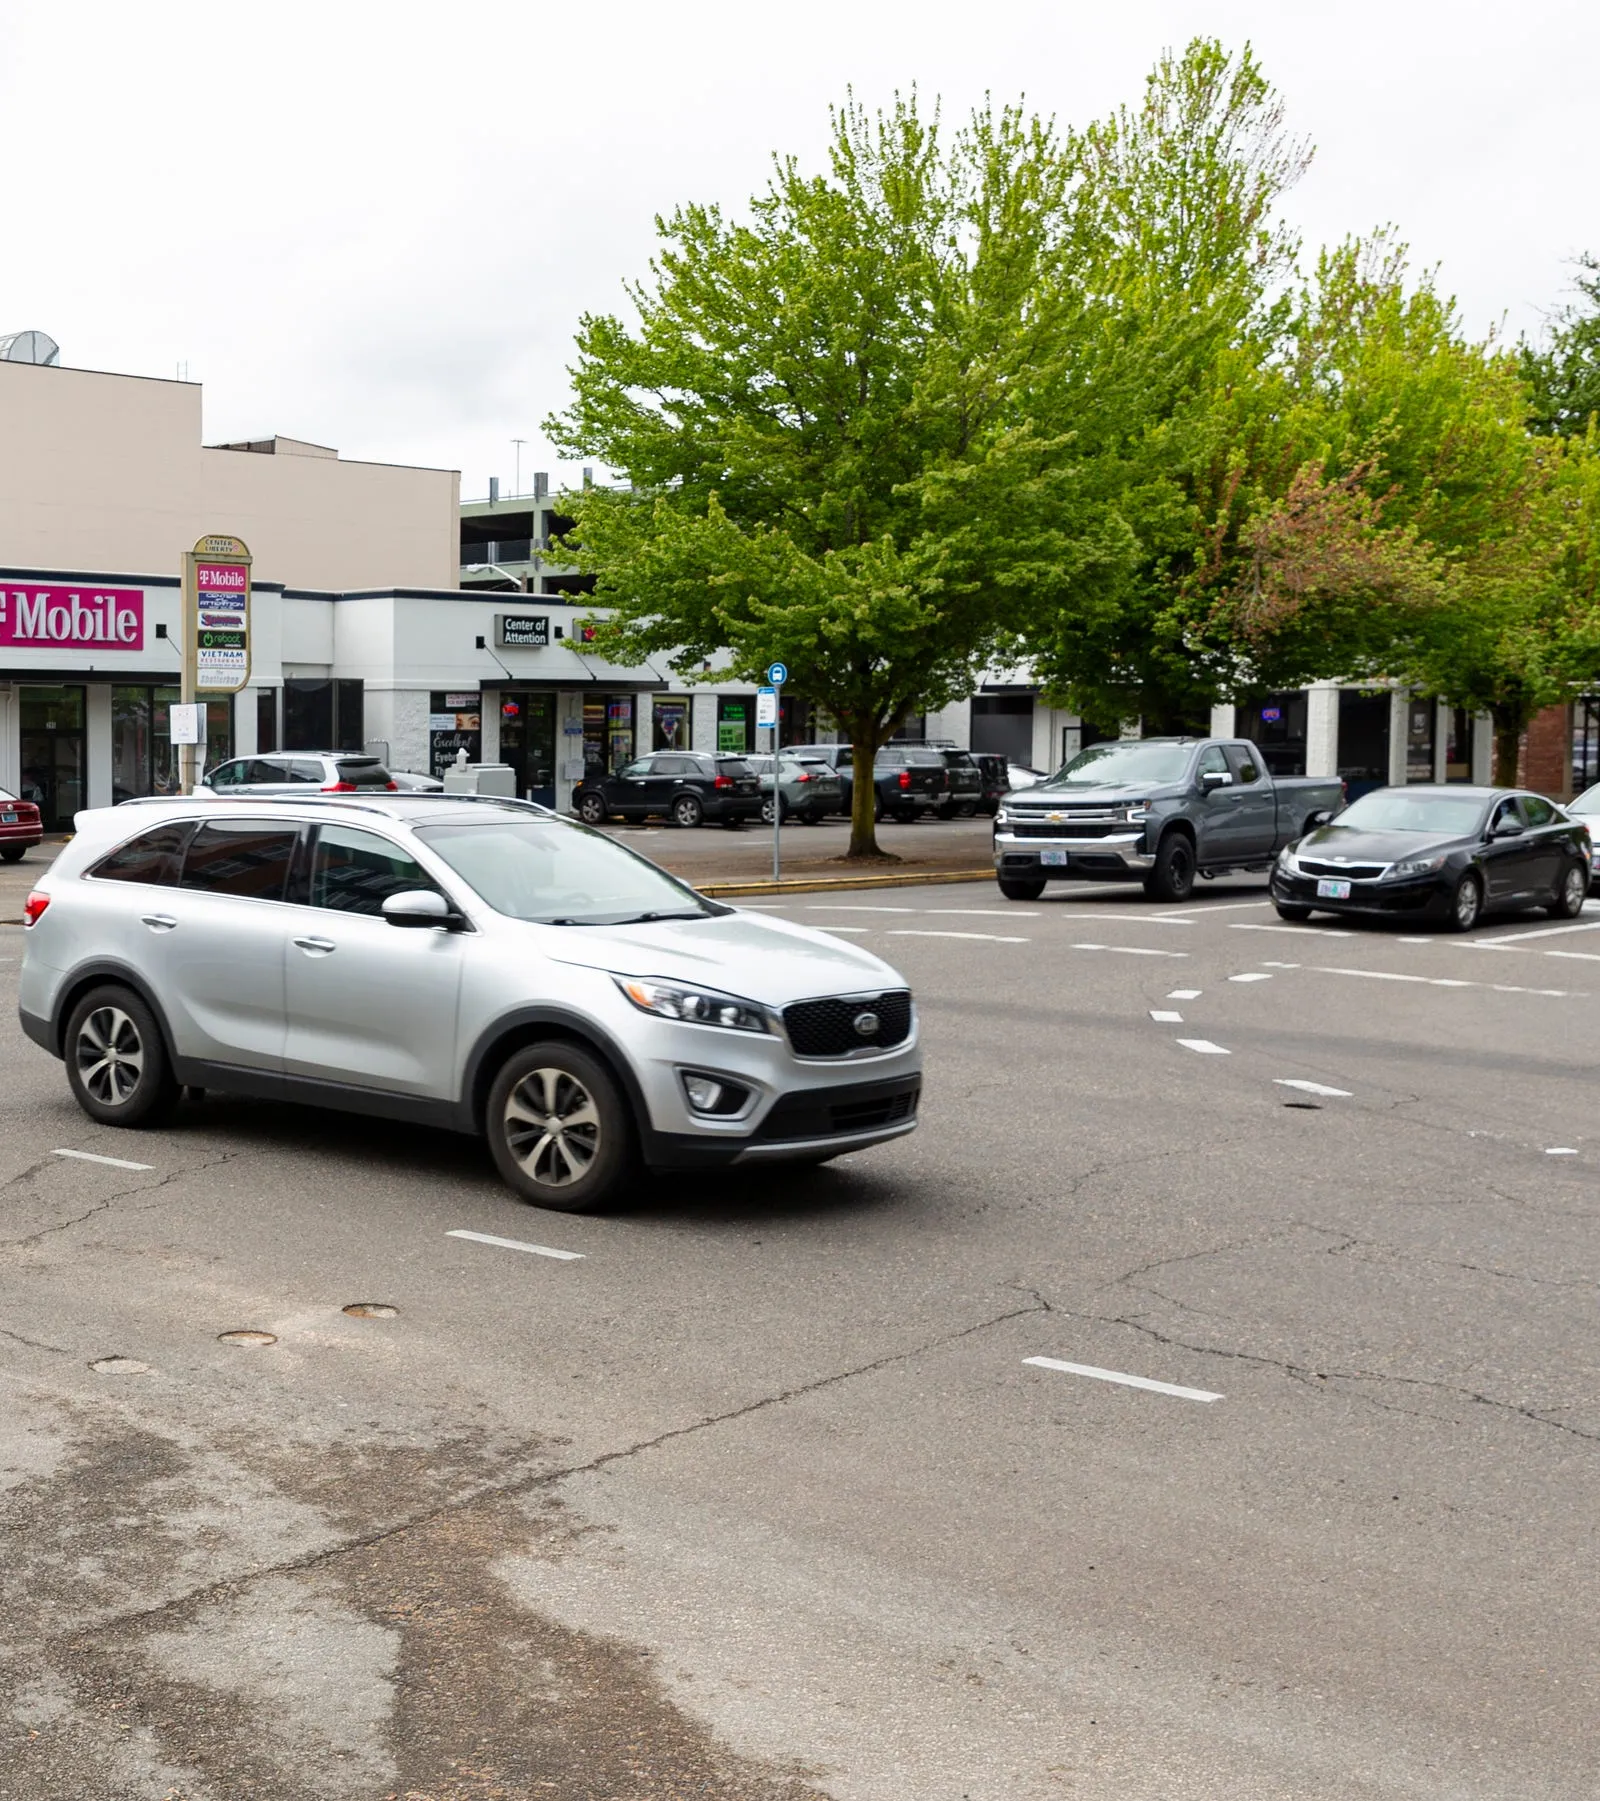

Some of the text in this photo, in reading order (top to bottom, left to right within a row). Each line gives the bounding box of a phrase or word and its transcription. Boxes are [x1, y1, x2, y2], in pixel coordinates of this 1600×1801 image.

[205, 538, 233, 546] CENTER
[205, 545, 233, 553] LIBERTY
[209, 570, 245, 587] Mobile
[11, 591, 138, 644] Mobile
[505, 618, 547, 631] Center of
[214, 632, 242, 643] reboot
[504, 631, 547, 644] Attention
[201, 650, 244, 658] VIETNAM
[433, 731, 473, 749] Excellent
